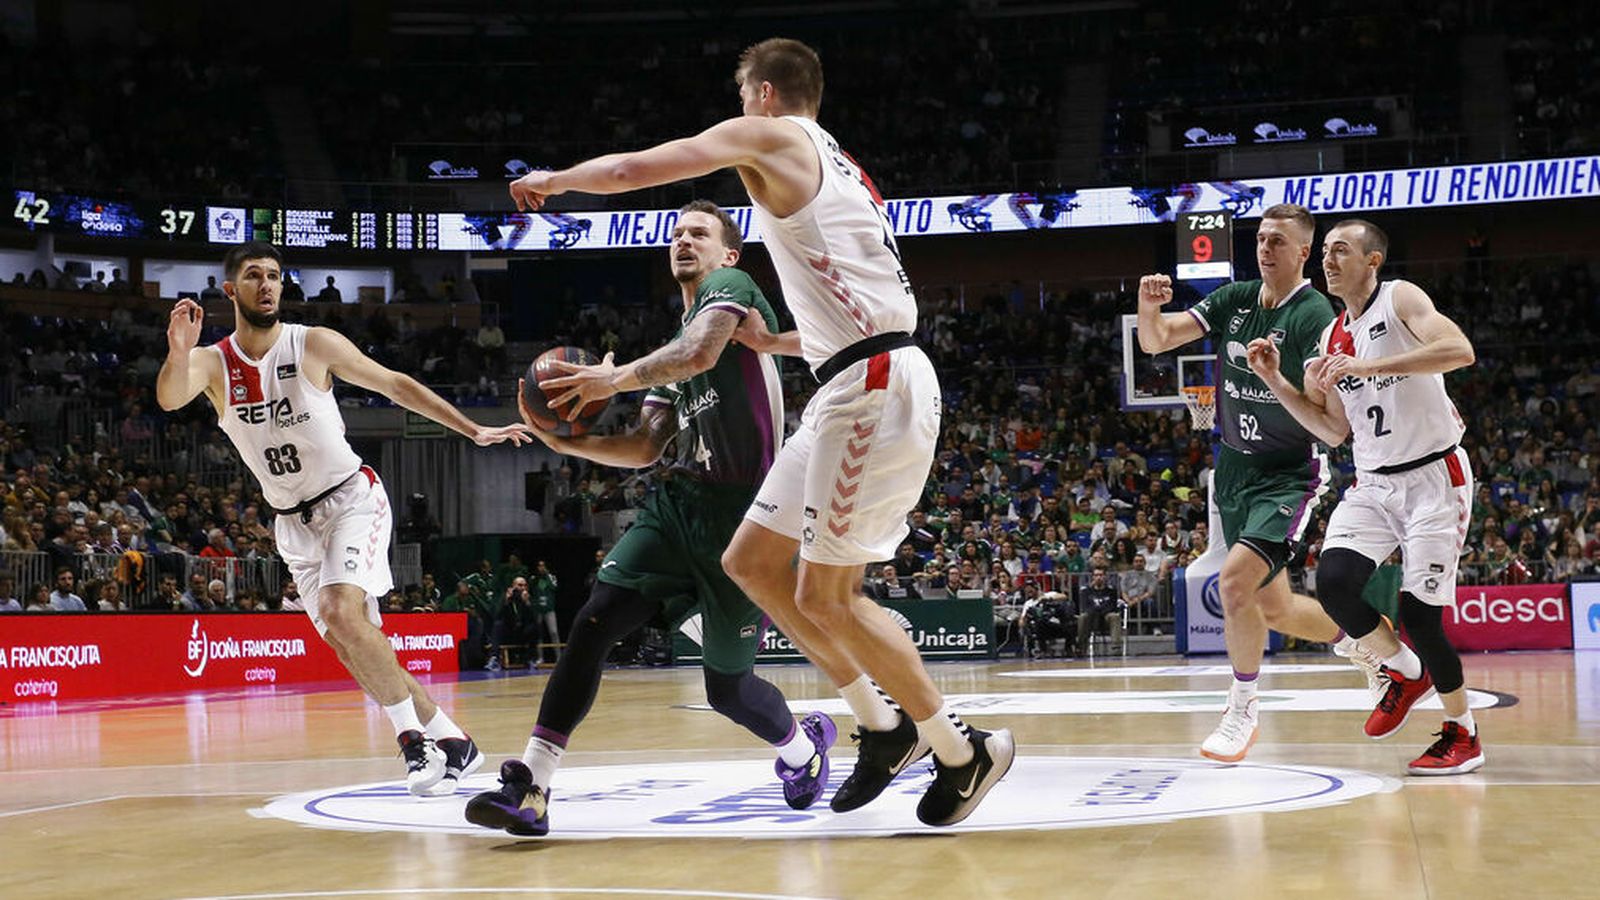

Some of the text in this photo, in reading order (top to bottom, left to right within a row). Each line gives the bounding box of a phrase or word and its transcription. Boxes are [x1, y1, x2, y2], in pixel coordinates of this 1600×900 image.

[1283, 172, 1393, 211] MEJORA
[1407, 169, 1440, 205] TU
[14, 197, 50, 224] 42
[160, 209, 195, 234] 37
[1188, 215, 1225, 230] 7:24
[1192, 235, 1212, 262] 9
[237, 396, 292, 426] RETA
[1367, 405, 1392, 437] 2
[1239, 413, 1263, 440] 52
[264, 443, 302, 476] 83
[210, 637, 306, 660] DOÑA FRANCISQUITA
[404, 634, 454, 652] FRANCISQUITA
[909, 626, 987, 650] Unicaja
[11, 645, 101, 670] FRANCISQUITA
[245, 666, 276, 682] catering
[14, 679, 58, 698] catering
